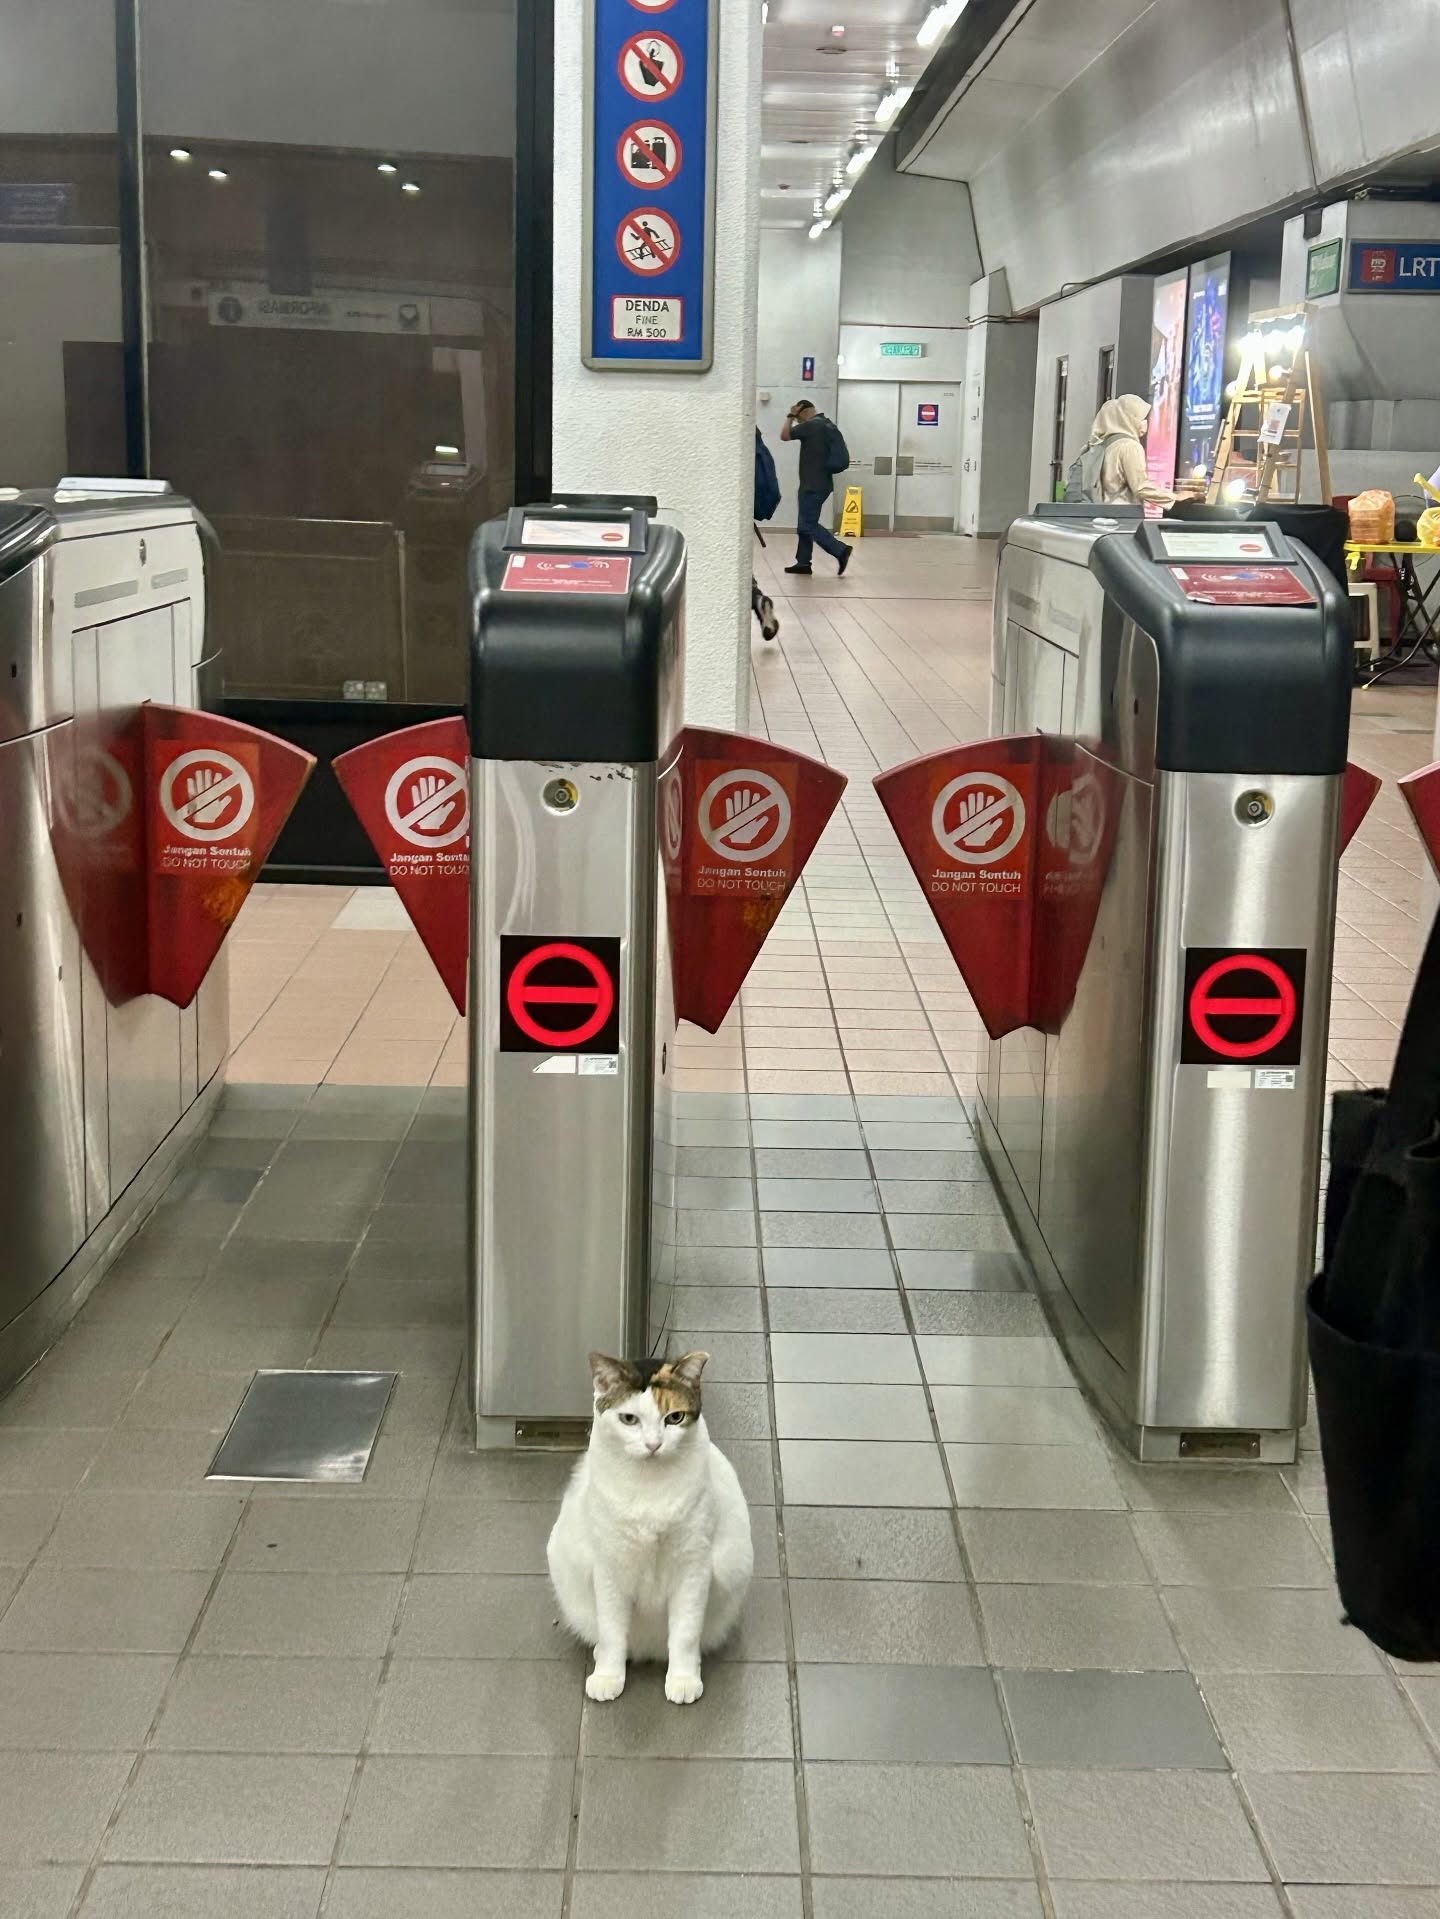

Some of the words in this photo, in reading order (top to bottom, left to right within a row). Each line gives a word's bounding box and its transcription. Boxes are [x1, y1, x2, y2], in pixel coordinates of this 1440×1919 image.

[1400, 256, 1440, 277] LRT
[625, 299, 670, 312] DENDA
[635, 314, 659, 325] FINE
[627, 327, 643, 337] RM
[646, 328, 667, 338] 500
[163, 844, 207, 857] Jangan
[210, 846, 252, 857] Sentuh
[161, 857, 181, 868] DO
[183, 857, 208, 869] NOT
[211, 858, 251, 870] TOUCH
[390, 852, 433, 864] Jangan
[389, 865, 408, 876] DO
[410, 865, 435, 876] NOT
[698, 866, 741, 878] Jangan
[744, 867, 786, 878] Sentuh
[932, 868, 976, 881] Jangan
[979, 869, 1021, 880] Sentuh
[697, 878, 715, 889] DO
[717, 878, 743, 889] NOT
[744, 879, 786, 892] TOUCH
[931, 881, 950, 892] DO
[952, 882, 977, 893] NOT
[978, 882, 1021, 893] TOUCH
